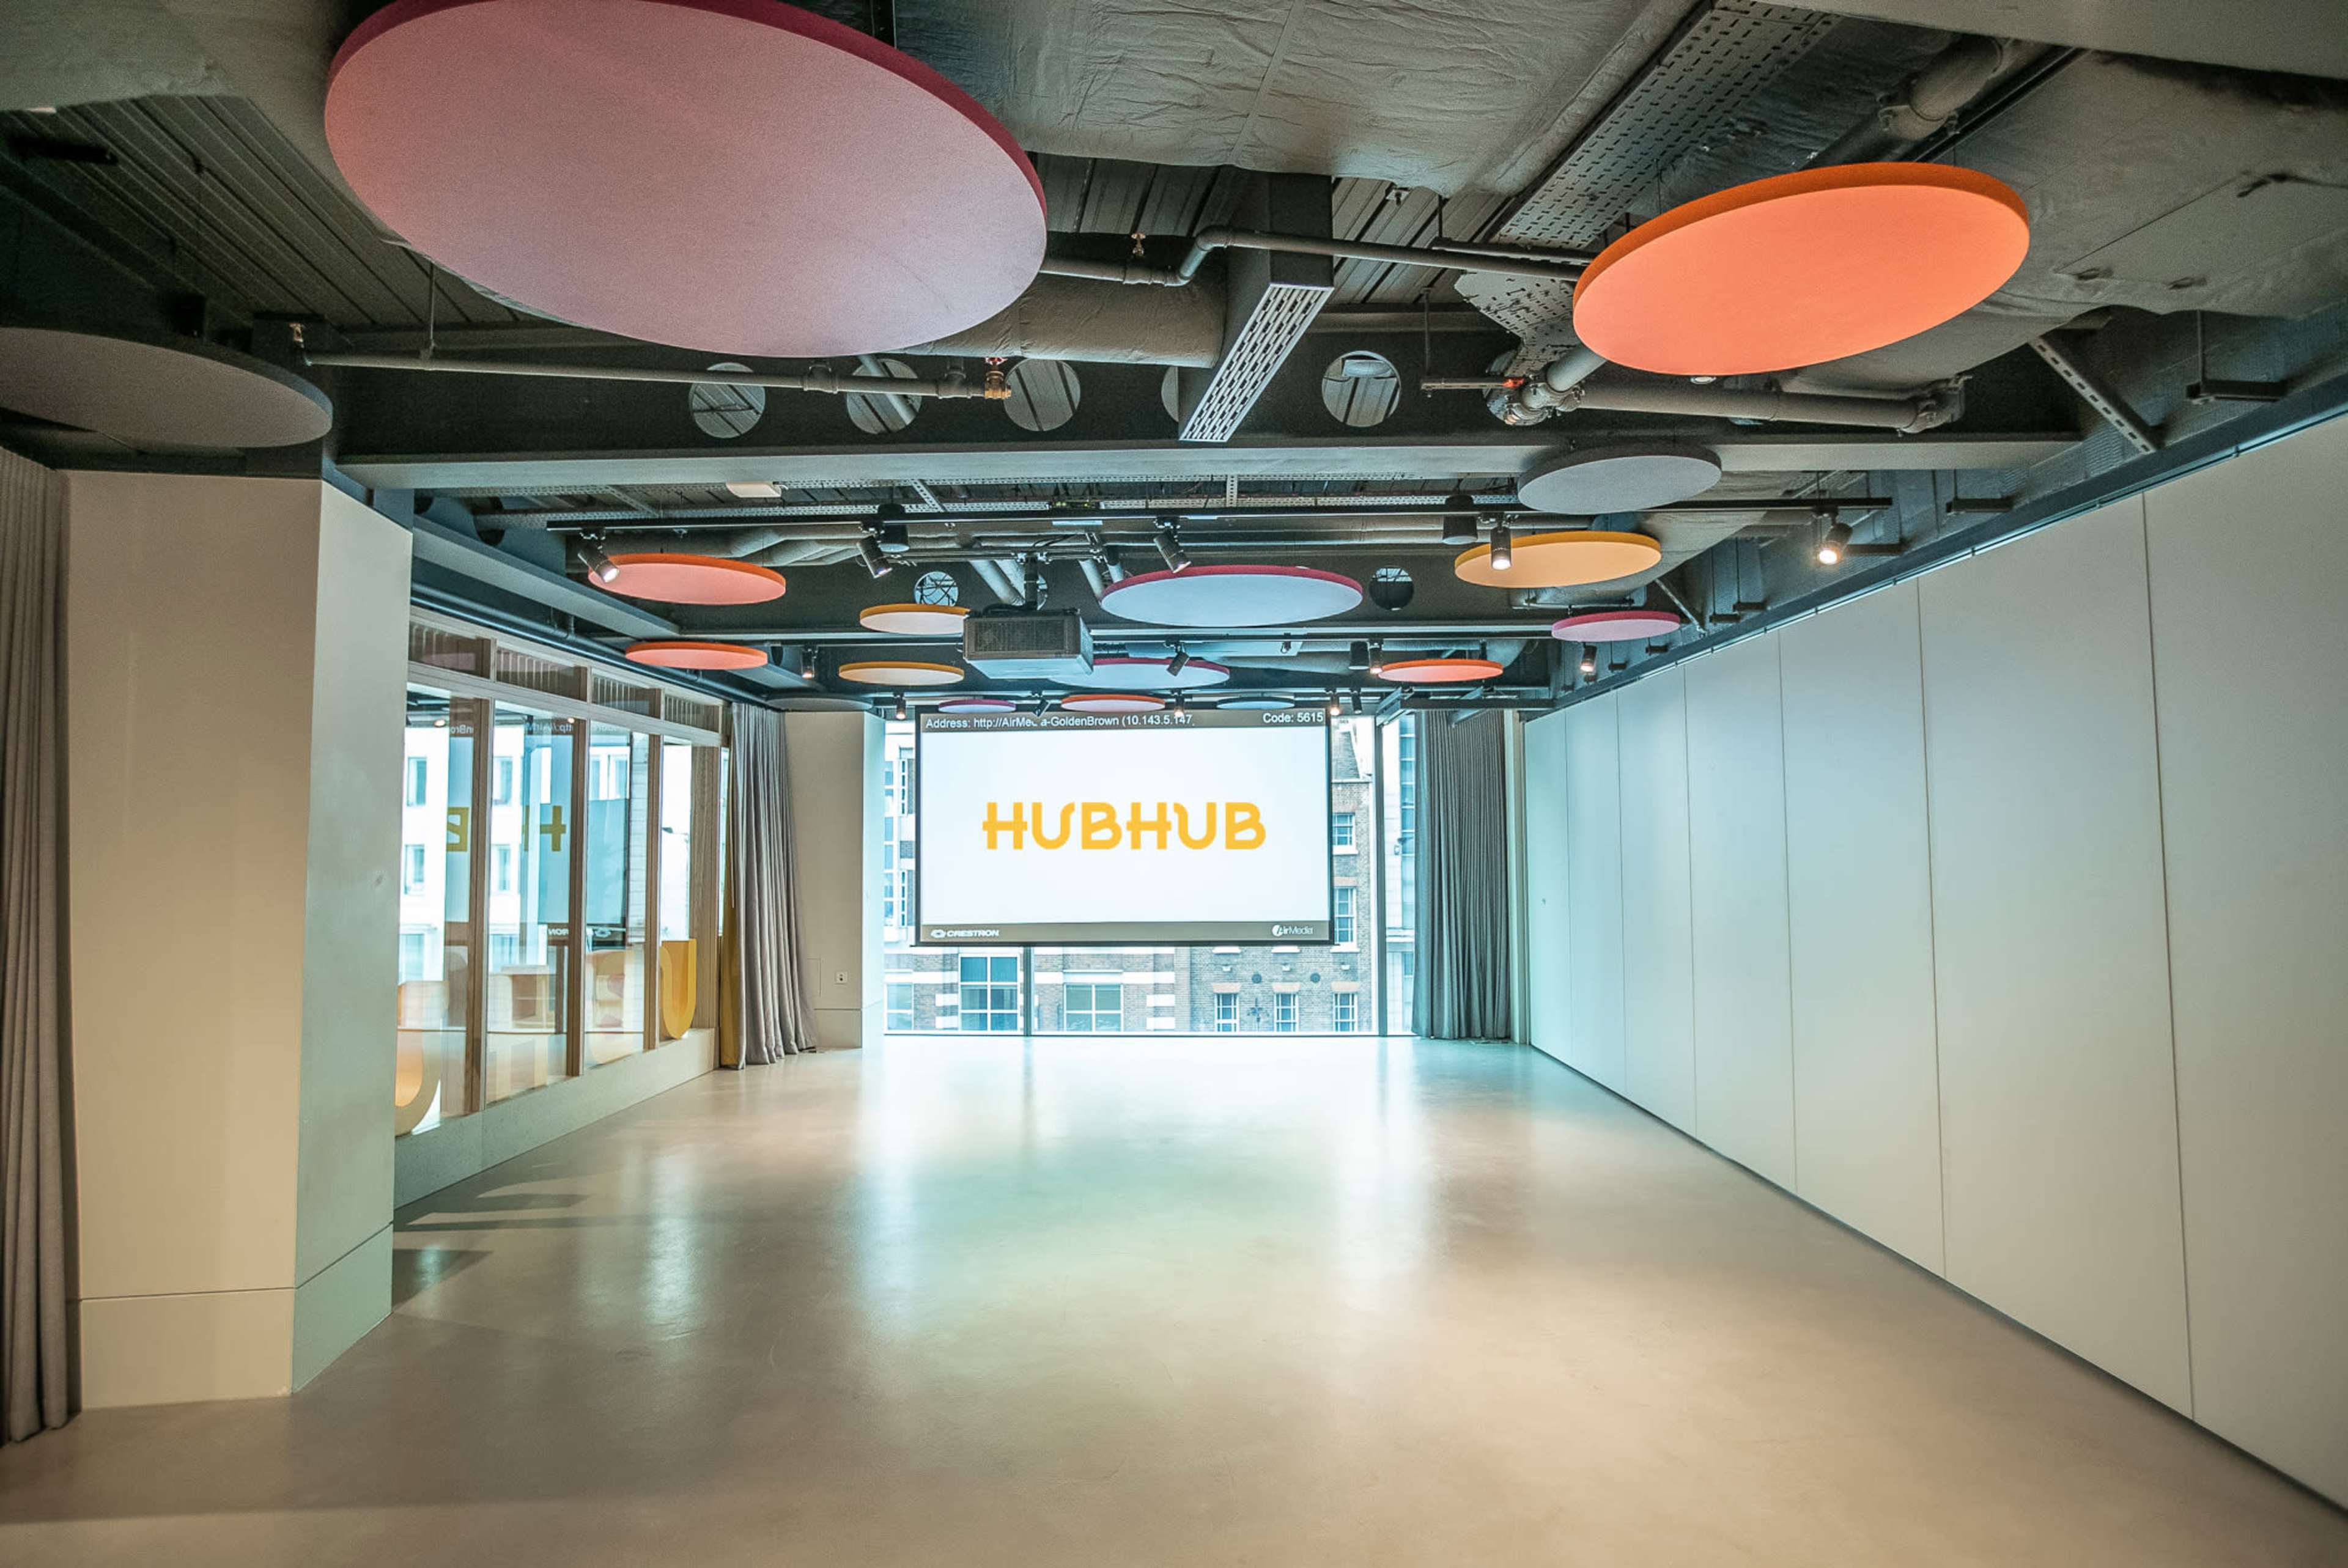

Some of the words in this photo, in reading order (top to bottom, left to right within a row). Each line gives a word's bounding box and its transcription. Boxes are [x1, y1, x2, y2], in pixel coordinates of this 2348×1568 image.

[926, 718, 971, 729] Address:
[974, 715, 1119, 729] http://AirMea-GoldenBrown
[1122, 713, 1195, 727] (10.143.5.147
[1263, 713, 1294, 723] Code:
[1297, 712, 1323, 723] 5615
[982, 802, 1266, 850] HUBHUB
